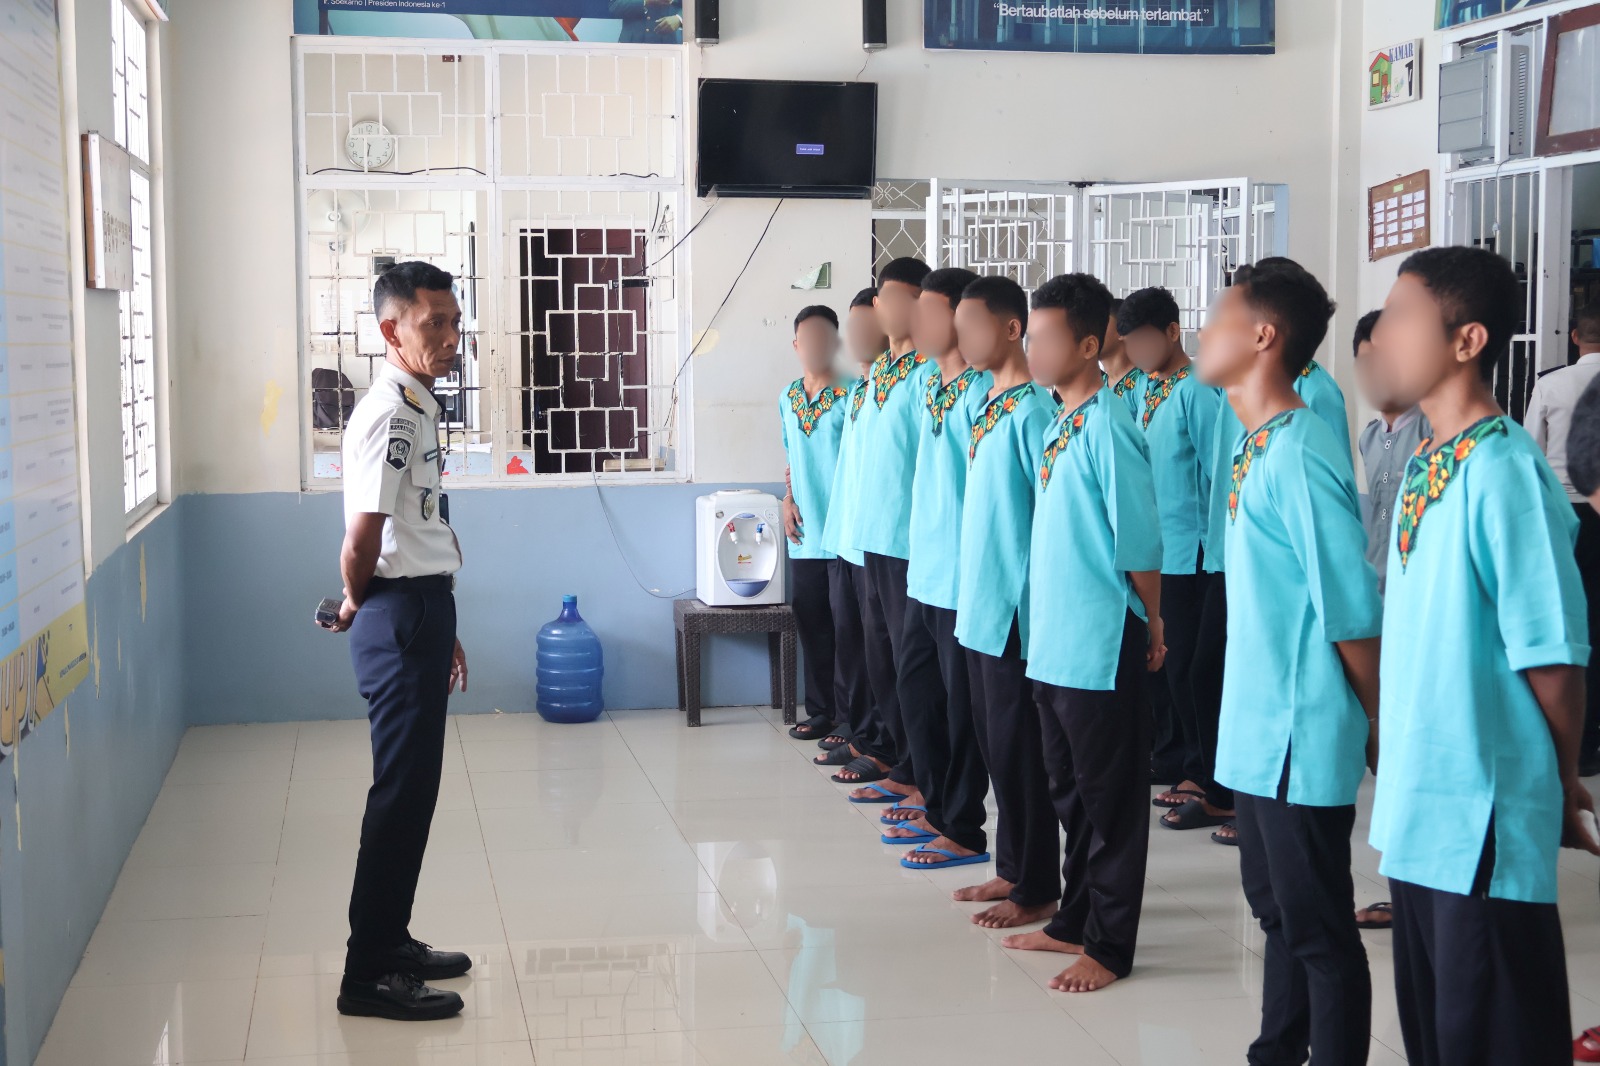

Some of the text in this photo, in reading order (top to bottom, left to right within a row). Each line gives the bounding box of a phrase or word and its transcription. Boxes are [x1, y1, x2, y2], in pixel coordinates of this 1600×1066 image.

[398, 0, 431, 8] Indonesia
[431, 0, 446, 8] ke-1
[1083, 6, 1139, 20] sebelum
[1389, 43, 1414, 62] KAMAR
